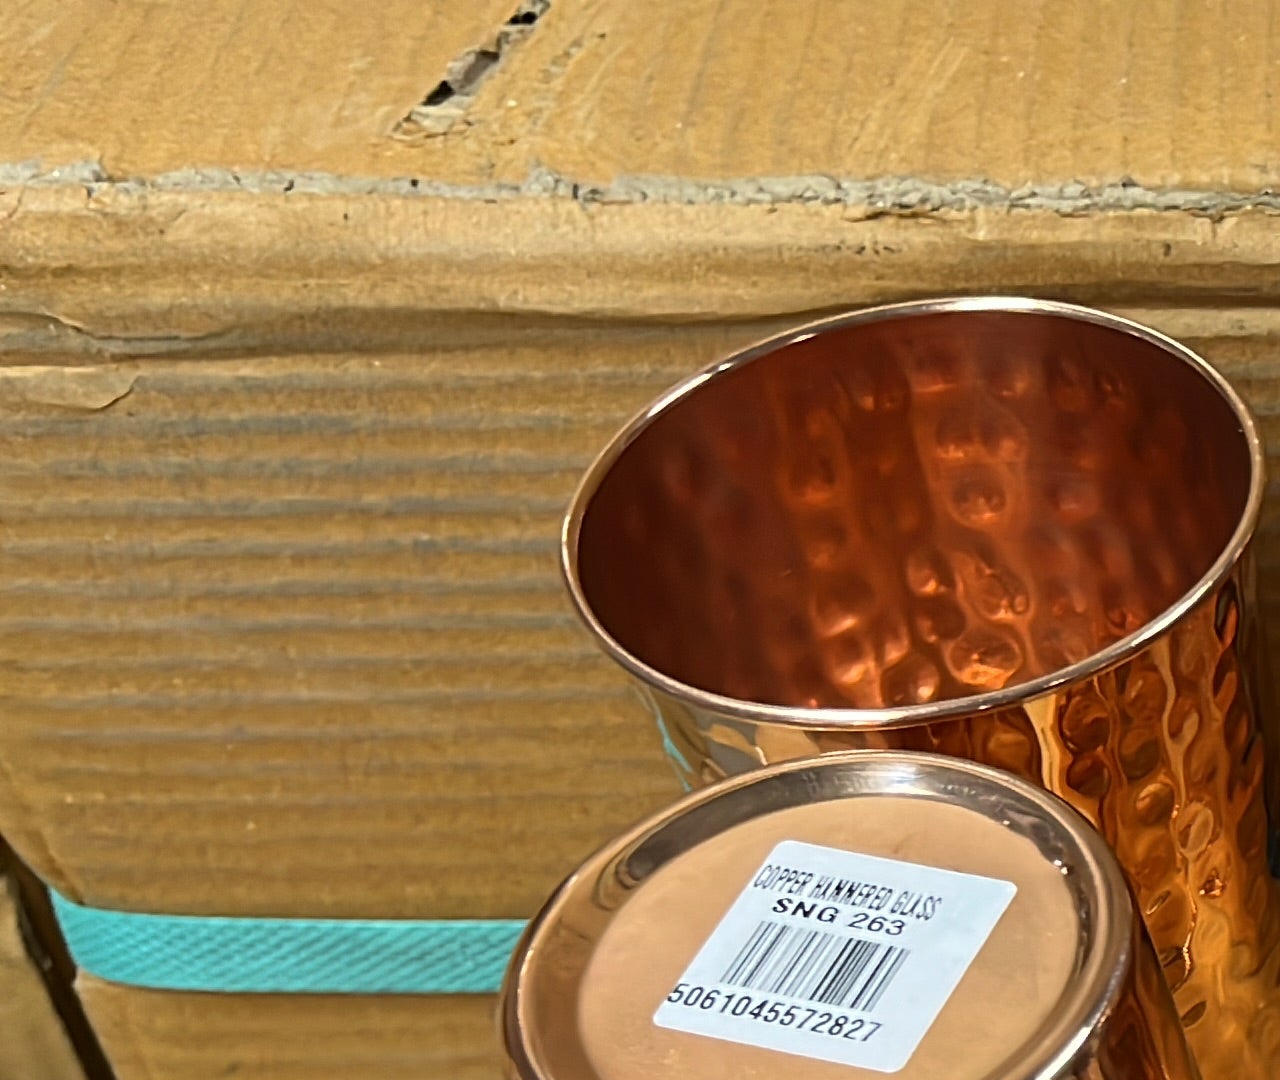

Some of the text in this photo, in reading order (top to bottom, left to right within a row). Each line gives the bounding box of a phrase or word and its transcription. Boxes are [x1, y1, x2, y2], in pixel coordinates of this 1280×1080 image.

[753, 864, 942, 921] COPPER HAMMERED GLASS
[772, 897, 906, 936] SNG 263
[667, 983, 883, 1042] 5061045572827
